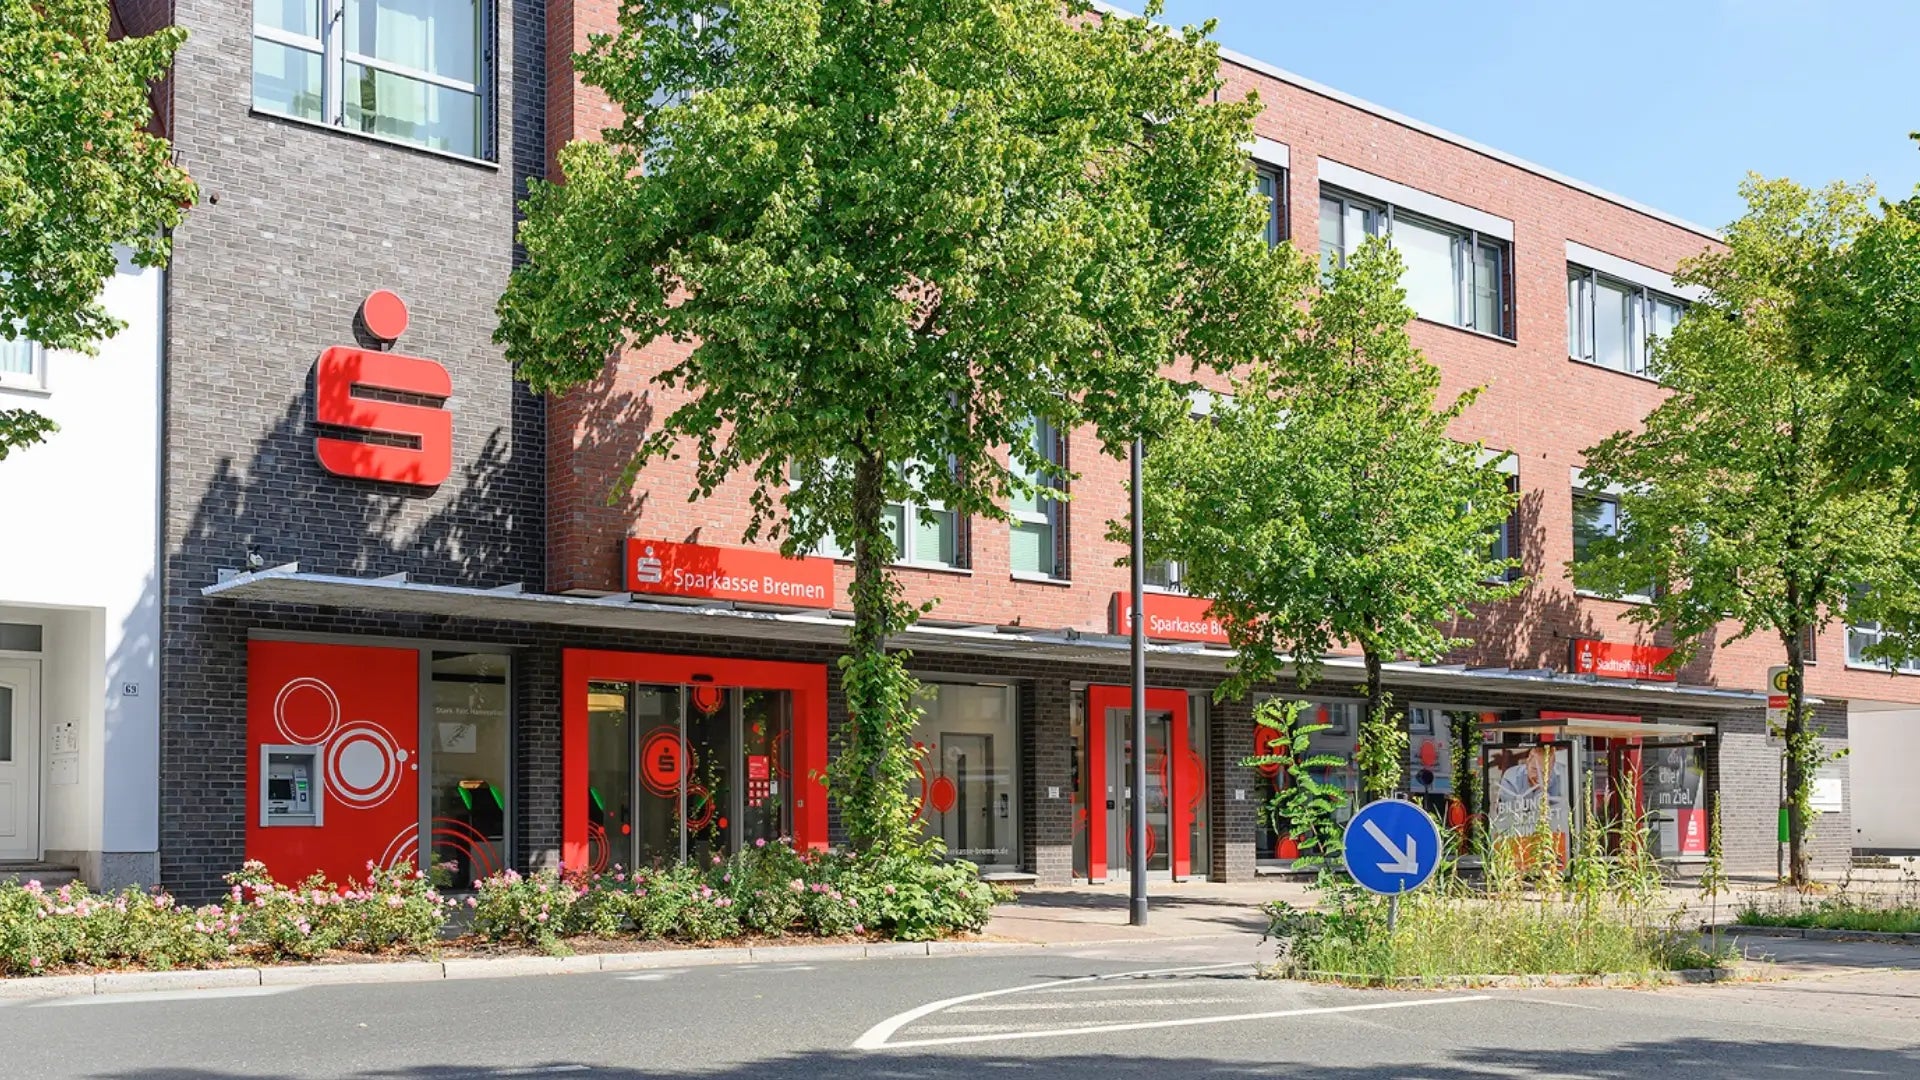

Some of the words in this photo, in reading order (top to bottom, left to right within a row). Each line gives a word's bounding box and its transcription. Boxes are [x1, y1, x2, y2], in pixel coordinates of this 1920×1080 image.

[673, 568, 758, 592] Sparkasse
[763, 576, 825, 599] Bremen
[1150, 614, 1208, 634] Sparkasse
[1672, 787, 1693, 805] Ziel.
